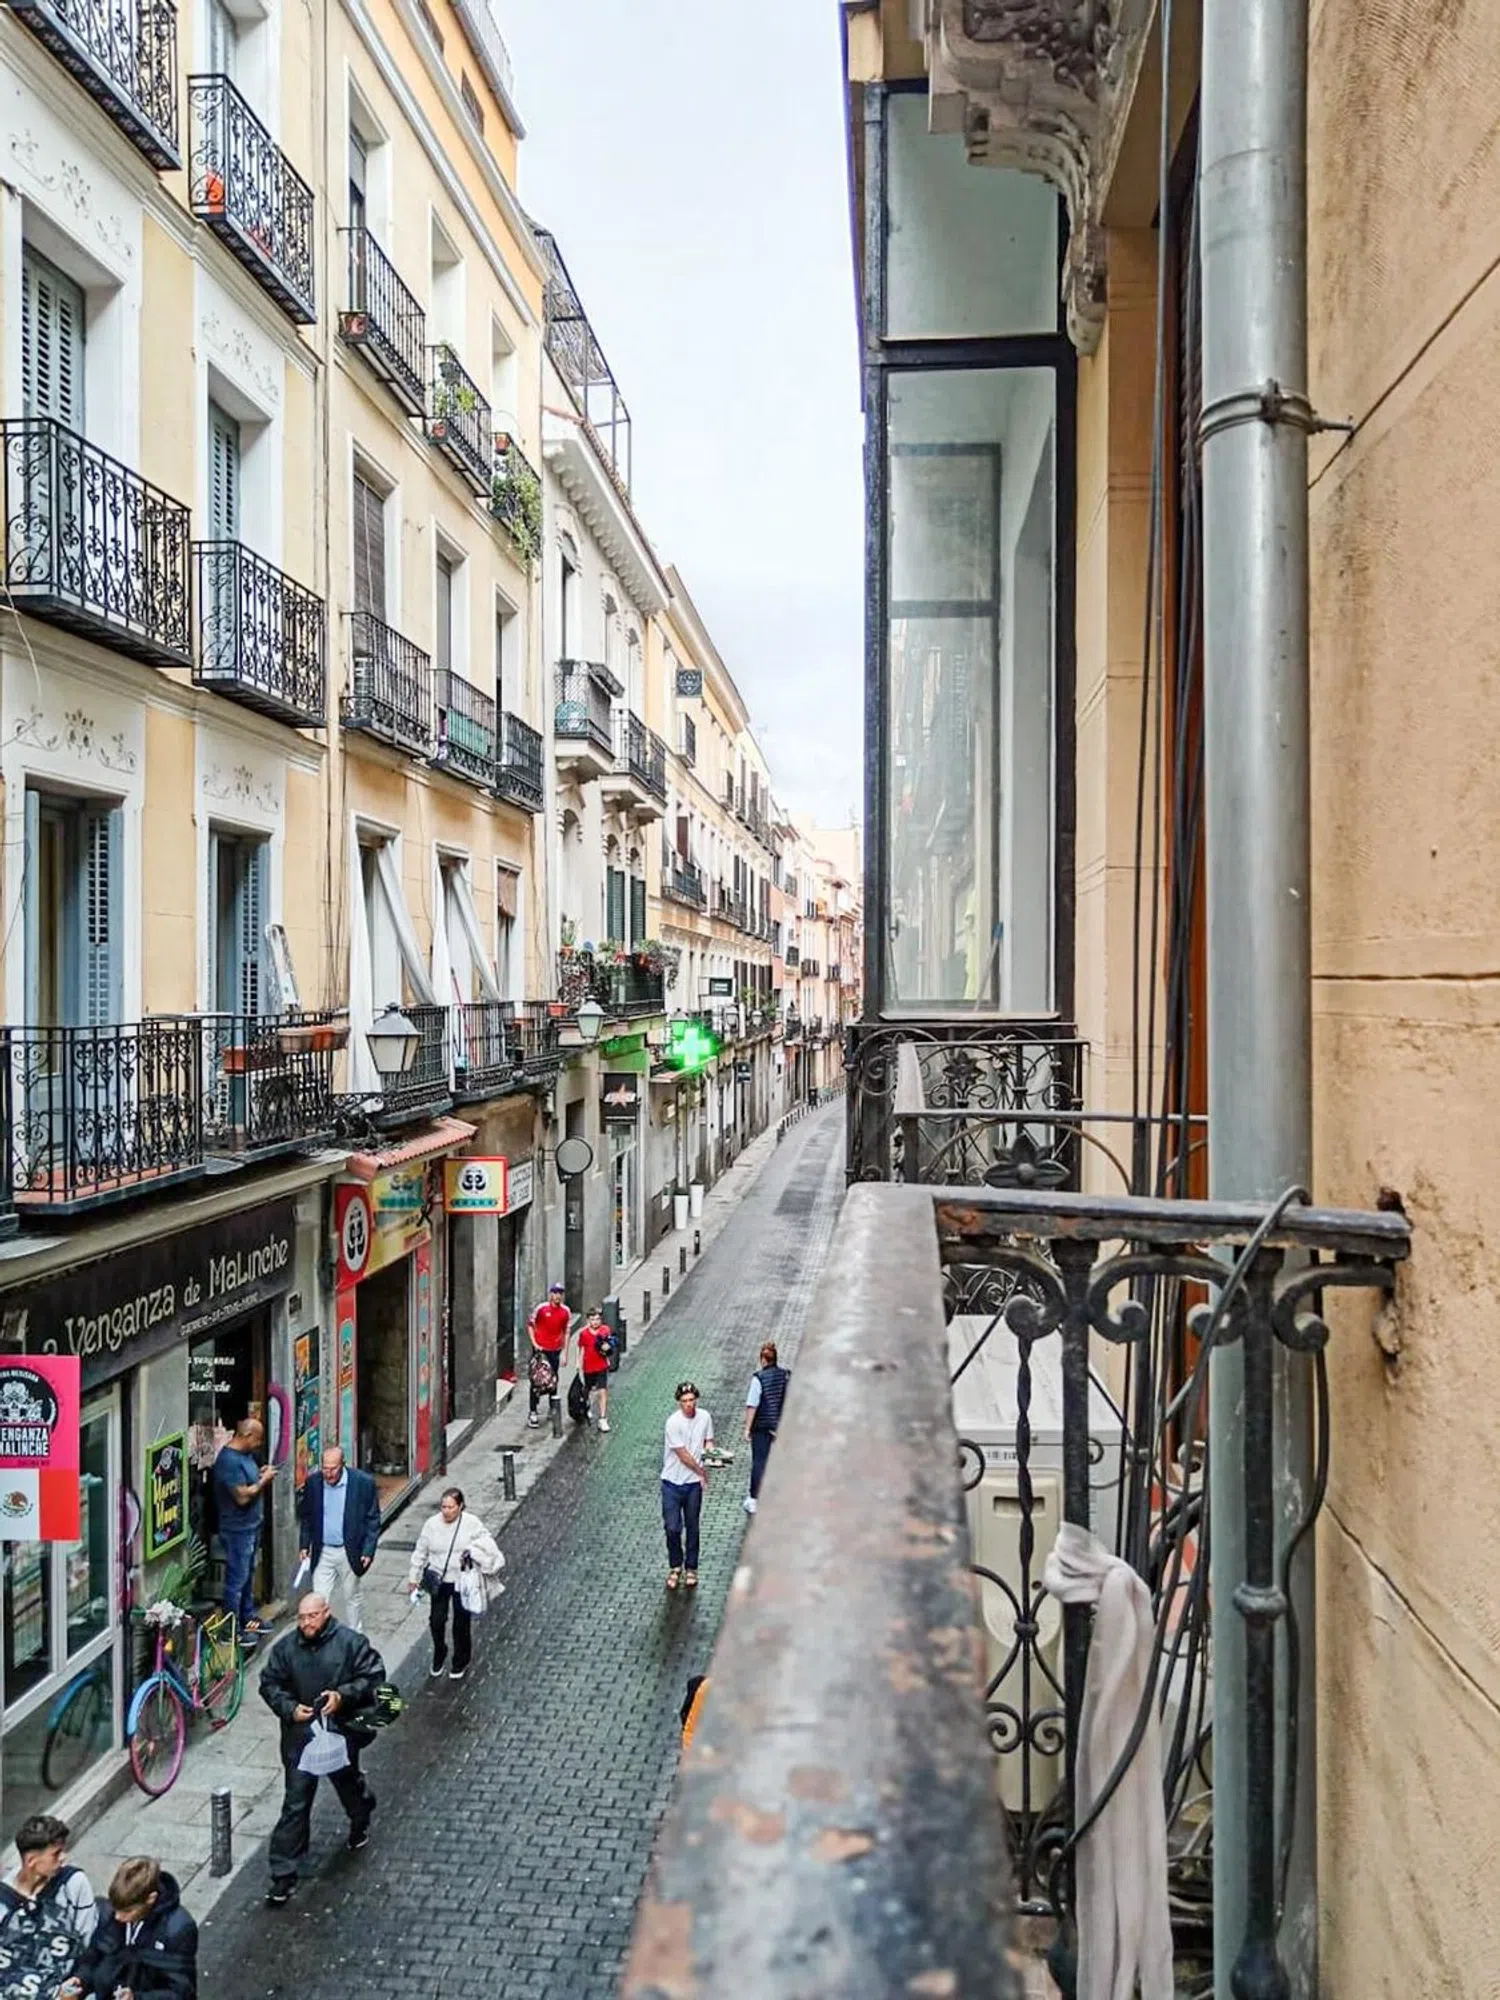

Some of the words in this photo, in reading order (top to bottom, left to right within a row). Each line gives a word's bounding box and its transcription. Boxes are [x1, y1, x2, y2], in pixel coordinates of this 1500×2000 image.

[65, 1284, 175, 1357] Venganza
[183, 1276, 200, 1308] de
[1, 1427, 48, 1440] ENGANZA
